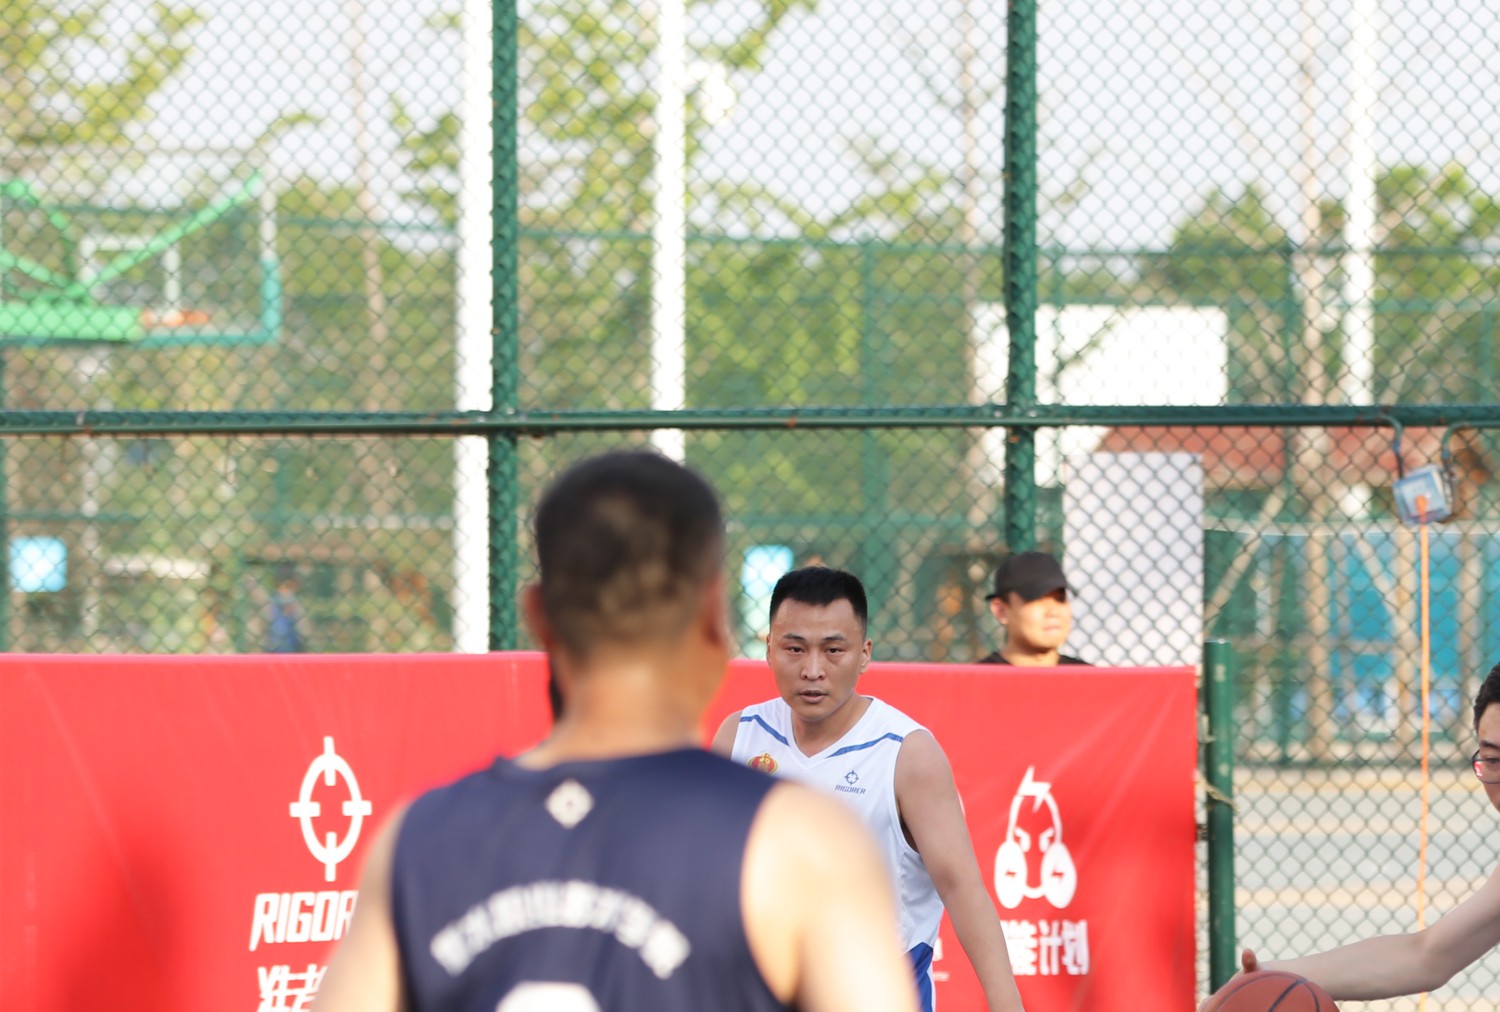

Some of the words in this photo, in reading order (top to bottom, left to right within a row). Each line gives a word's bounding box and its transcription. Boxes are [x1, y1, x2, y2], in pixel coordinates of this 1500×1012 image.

[835, 784, 866, 795] RIGORER
[1000, 919, 1090, 976] 能计划
